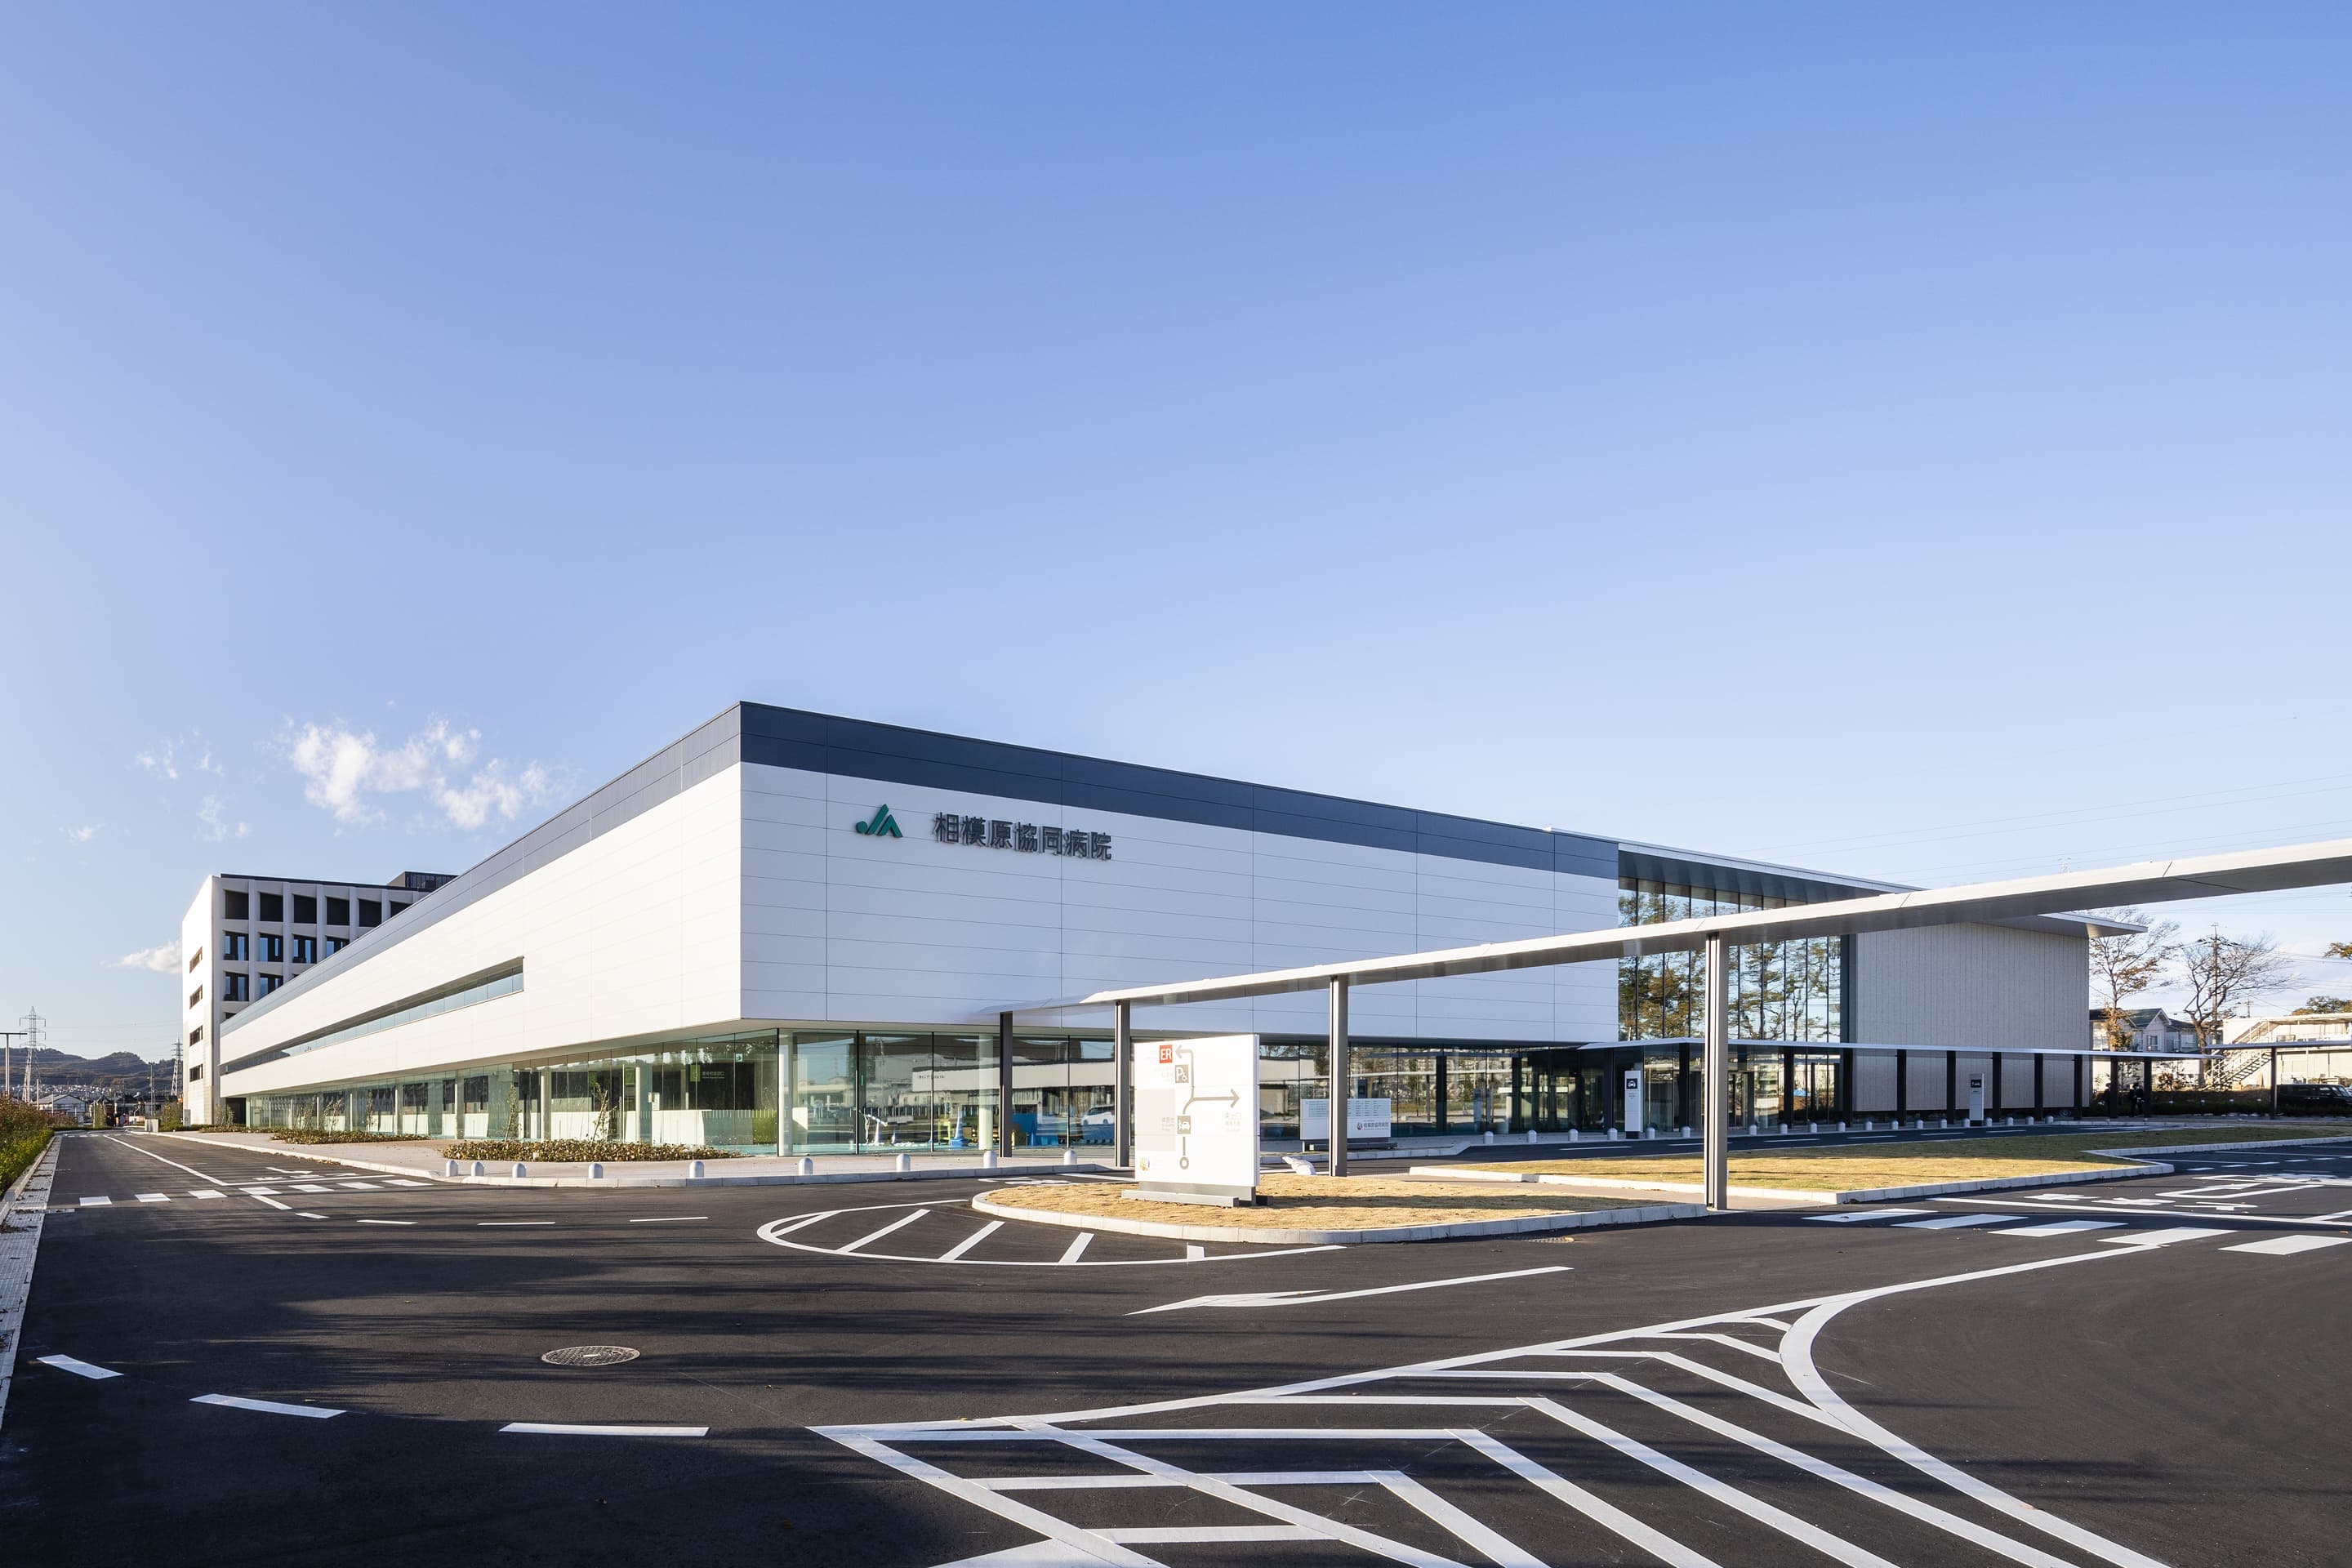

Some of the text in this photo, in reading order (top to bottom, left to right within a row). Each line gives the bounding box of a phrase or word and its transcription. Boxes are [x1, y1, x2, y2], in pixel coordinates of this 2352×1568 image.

[934, 812, 1112, 860] 相模原協同病院
[1160, 1048, 1172, 1060] ER
[1176, 1067, 1183, 1081] P
